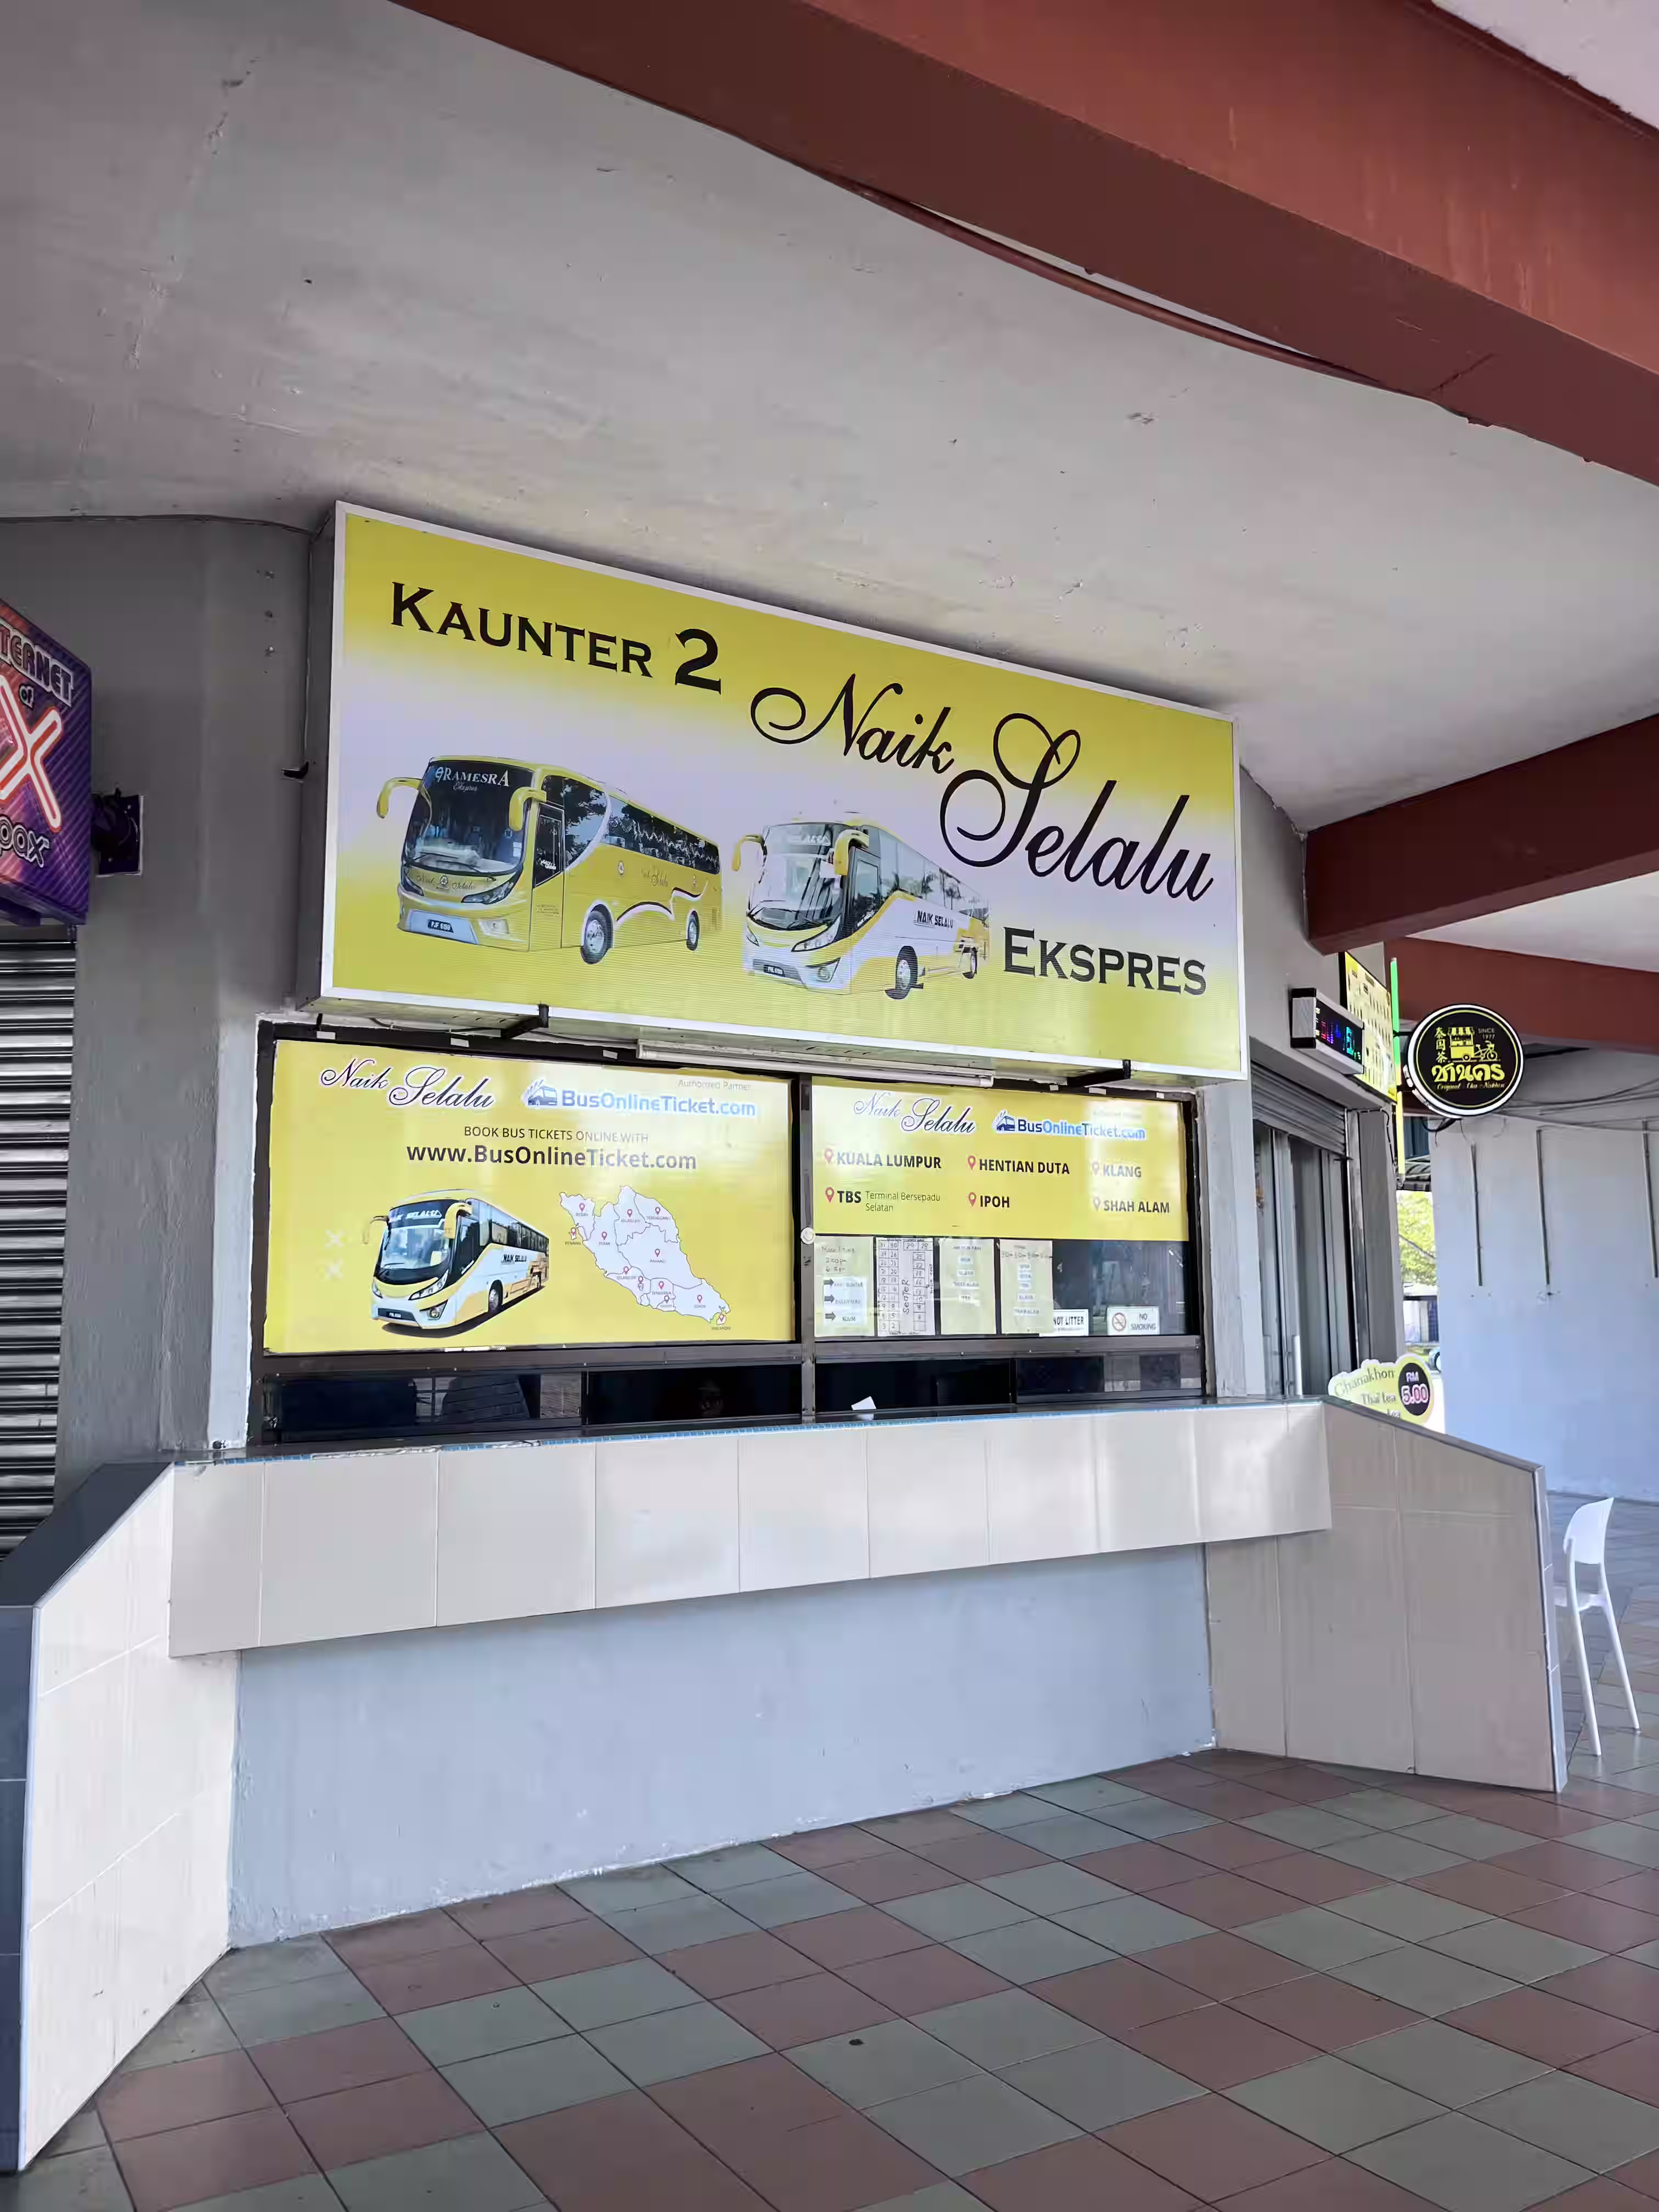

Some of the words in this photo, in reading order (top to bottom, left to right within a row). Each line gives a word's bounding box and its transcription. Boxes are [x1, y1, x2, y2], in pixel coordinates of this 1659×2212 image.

[391, 582, 653, 678] KAUNTER
[675, 628, 721, 695] 2
[751, 673, 955, 775] Naik
[939, 712, 1215, 902] Selalu
[917, 910, 933, 924] NAIK
[1003, 927, 1207, 996] EKSPRES
[321, 1059, 391, 1089] Naik
[389, 1066, 494, 1108] Selalu
[723, 1080, 751, 1090] Partner
[562, 1089, 755, 1116] BusOnlineTicket.com
[854, 1092, 902, 1117] Naik
[901, 1098, 975, 1133] Selalu
[464, 1126, 499, 1137] BOOK
[503, 1127, 525, 1138] BUS
[528, 1128, 573, 1141] TICKETS
[575, 1131, 618, 1142] ONLINE
[620, 1132, 648, 1143] WITH
[1018, 1119, 1145, 1139] BusOnlineTicket.com
[407, 1145, 696, 1169] www.BusOnlineTicket.com
[837, 1152, 883, 1166] KUALA
[887, 1154, 942, 1169] LUMPUR
[979, 1159, 1034, 1173] HENTIAN
[1038, 1161, 1070, 1175] DUTA
[1103, 1164, 1142, 1177] KLANG
[837, 1190, 861, 1203] TBS
[865, 1191, 898, 1200] Terminal
[901, 1192, 940, 1203] Bersepadu
[980, 1195, 1010, 1208] IPOH
[865, 1203, 894, 1212] Selatan
[1103, 1200, 1135, 1212] SHAH
[1138, 1201, 1170, 1213] ALAM
[1065, 1316, 1084, 1325] LITTER
[1406, 1372, 1419, 1382] RM
[1401, 1384, 1429, 1405] 5.00
